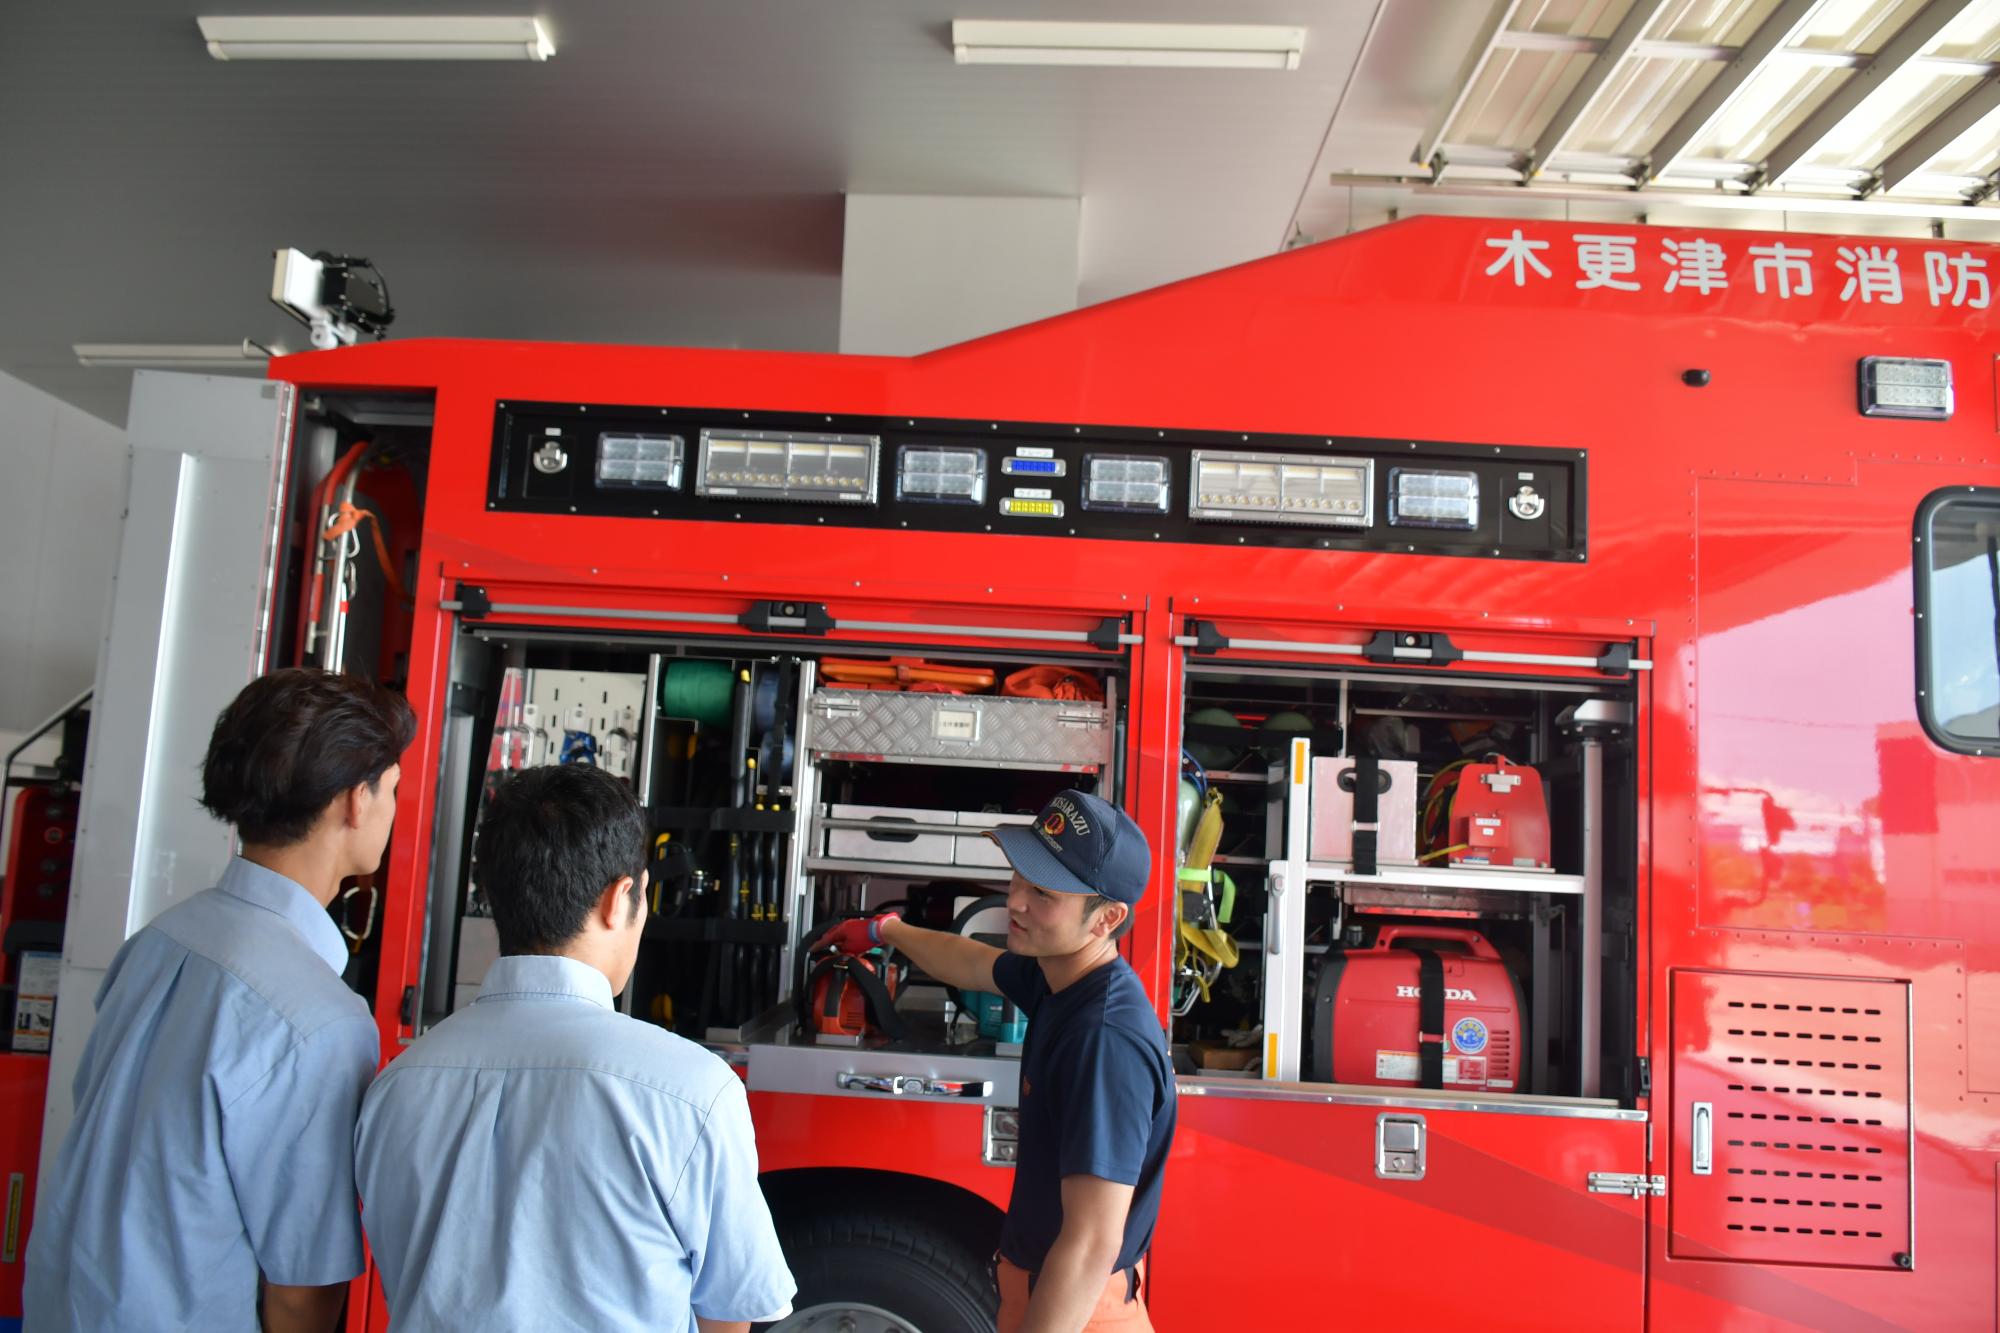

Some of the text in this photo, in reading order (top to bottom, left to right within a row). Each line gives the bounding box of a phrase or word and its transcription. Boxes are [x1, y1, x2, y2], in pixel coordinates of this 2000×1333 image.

[1486, 230, 1990, 308] 木更津市消防
[1396, 985, 1477, 1001] HDA
